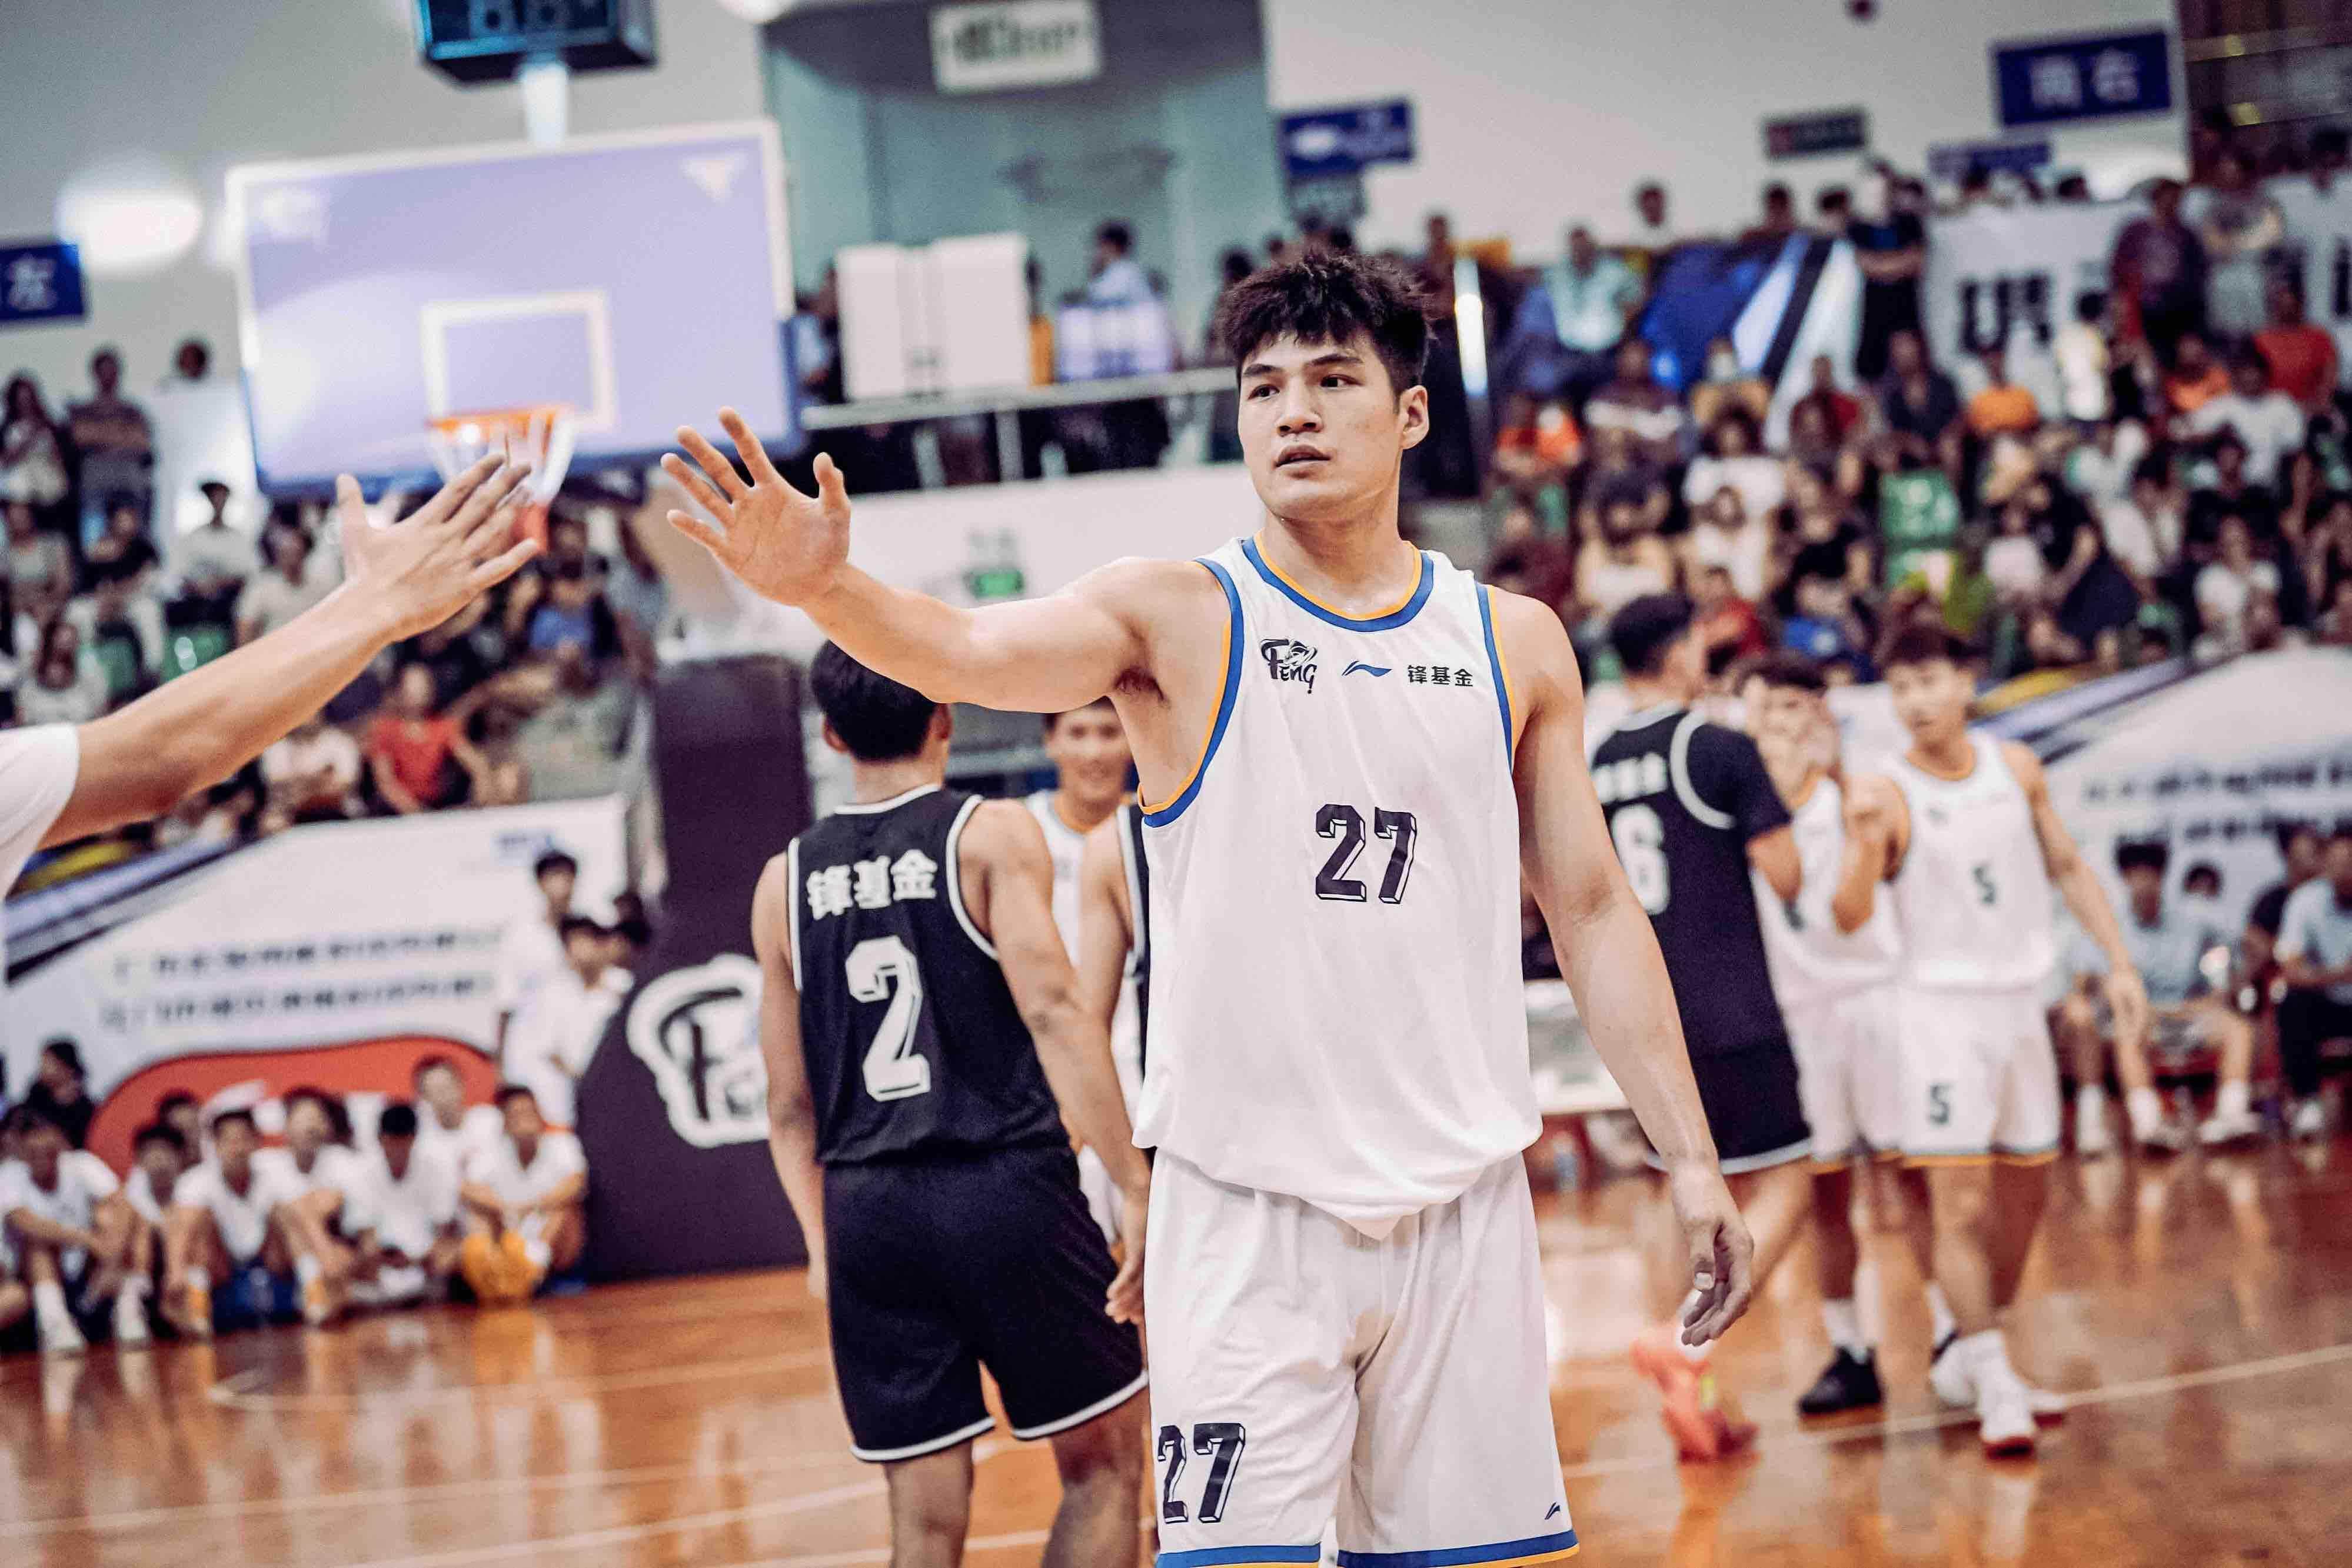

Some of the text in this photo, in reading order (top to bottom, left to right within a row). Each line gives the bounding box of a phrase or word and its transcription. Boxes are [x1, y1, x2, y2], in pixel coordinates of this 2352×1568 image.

[1407, 665, 1473, 687] 锋基金
[1316, 804, 1417, 904] 27
[1972, 861, 1997, 905] 5
[845, 935, 931, 1101] 2
[1927, 1082, 1951, 1125] 5
[1158, 1423, 1246, 1523] 27
